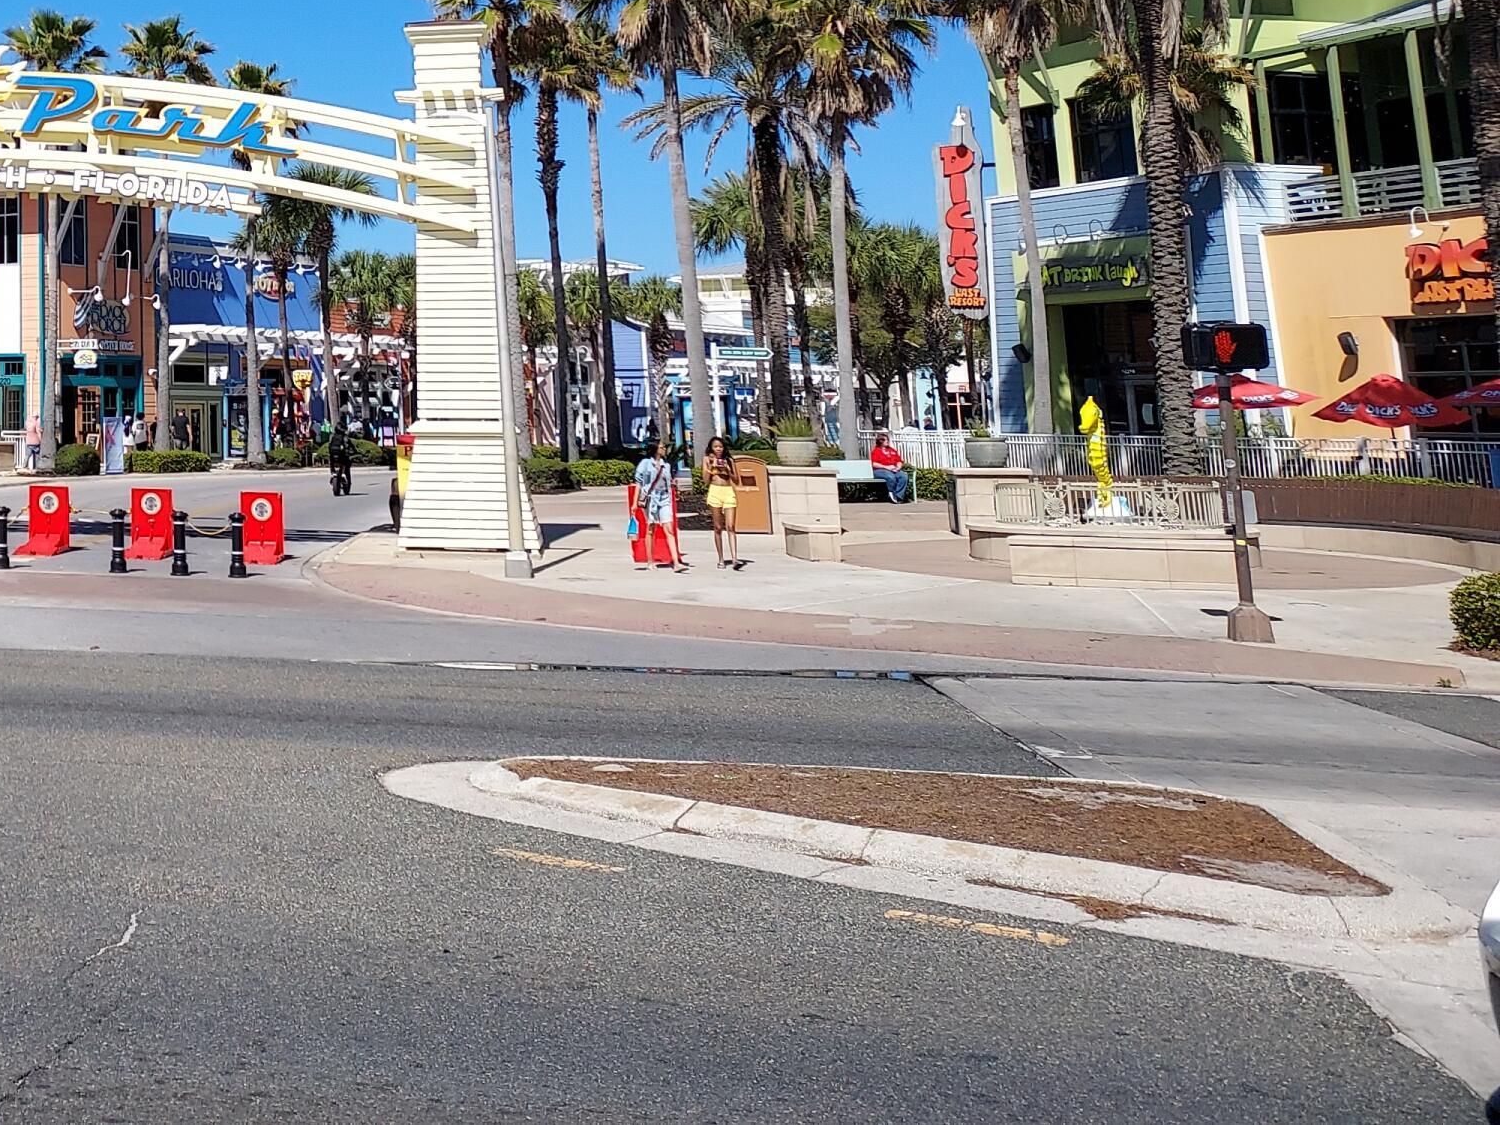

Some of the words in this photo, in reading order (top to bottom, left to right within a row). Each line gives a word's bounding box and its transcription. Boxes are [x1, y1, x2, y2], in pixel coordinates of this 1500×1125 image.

[13, 75, 299, 156] Park
[72, 169, 234, 211] FLORIDA
[939, 145, 979, 288] DICK'S
[1040, 264, 1063, 287] AT
[949, 296, 986, 308] RESORT
[954, 288, 981, 298] LAST
[1365, 404, 1402, 416] DICK'S
